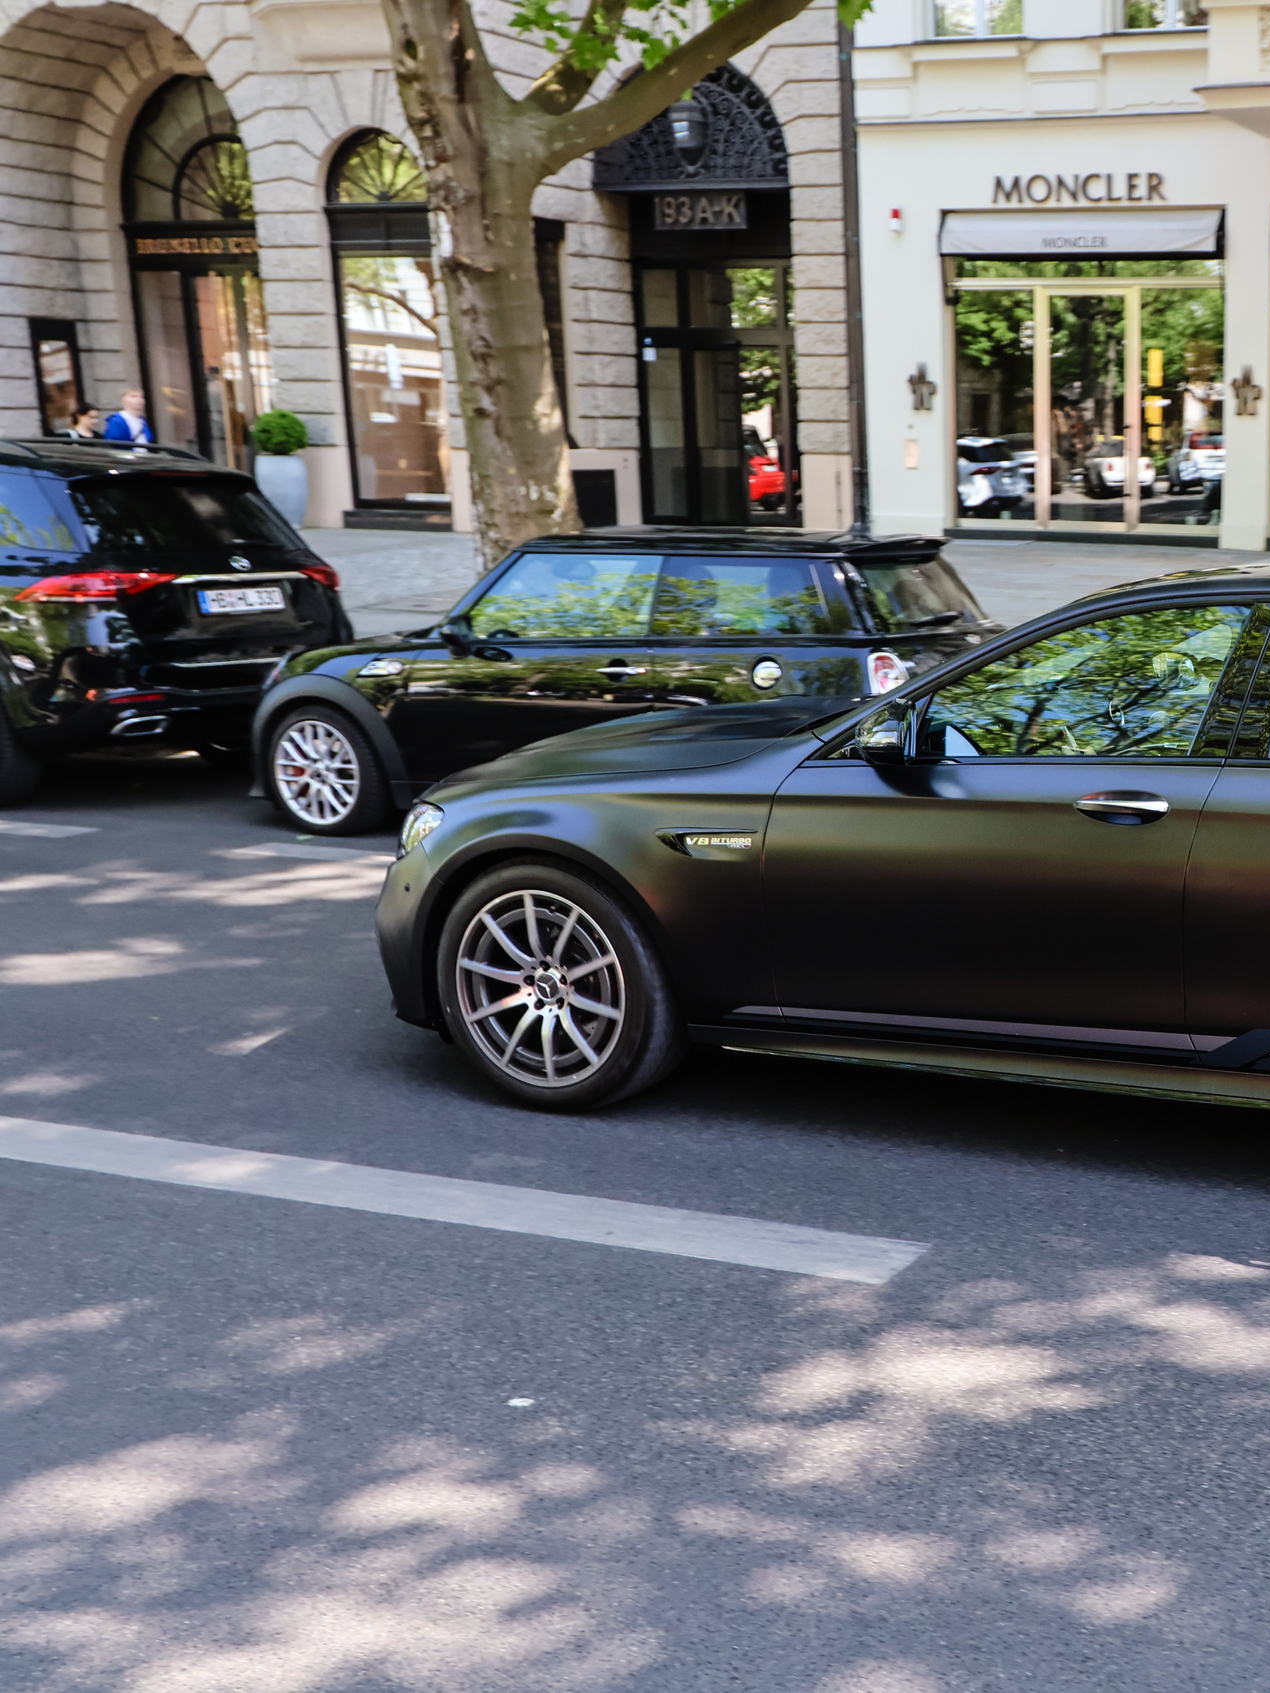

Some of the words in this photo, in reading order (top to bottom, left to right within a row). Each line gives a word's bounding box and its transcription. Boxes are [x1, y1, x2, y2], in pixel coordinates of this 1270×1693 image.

[992, 171, 1167, 205] MONCLER
[1041, 235, 1109, 249] MONCLER
[685, 836, 709, 846] V8
